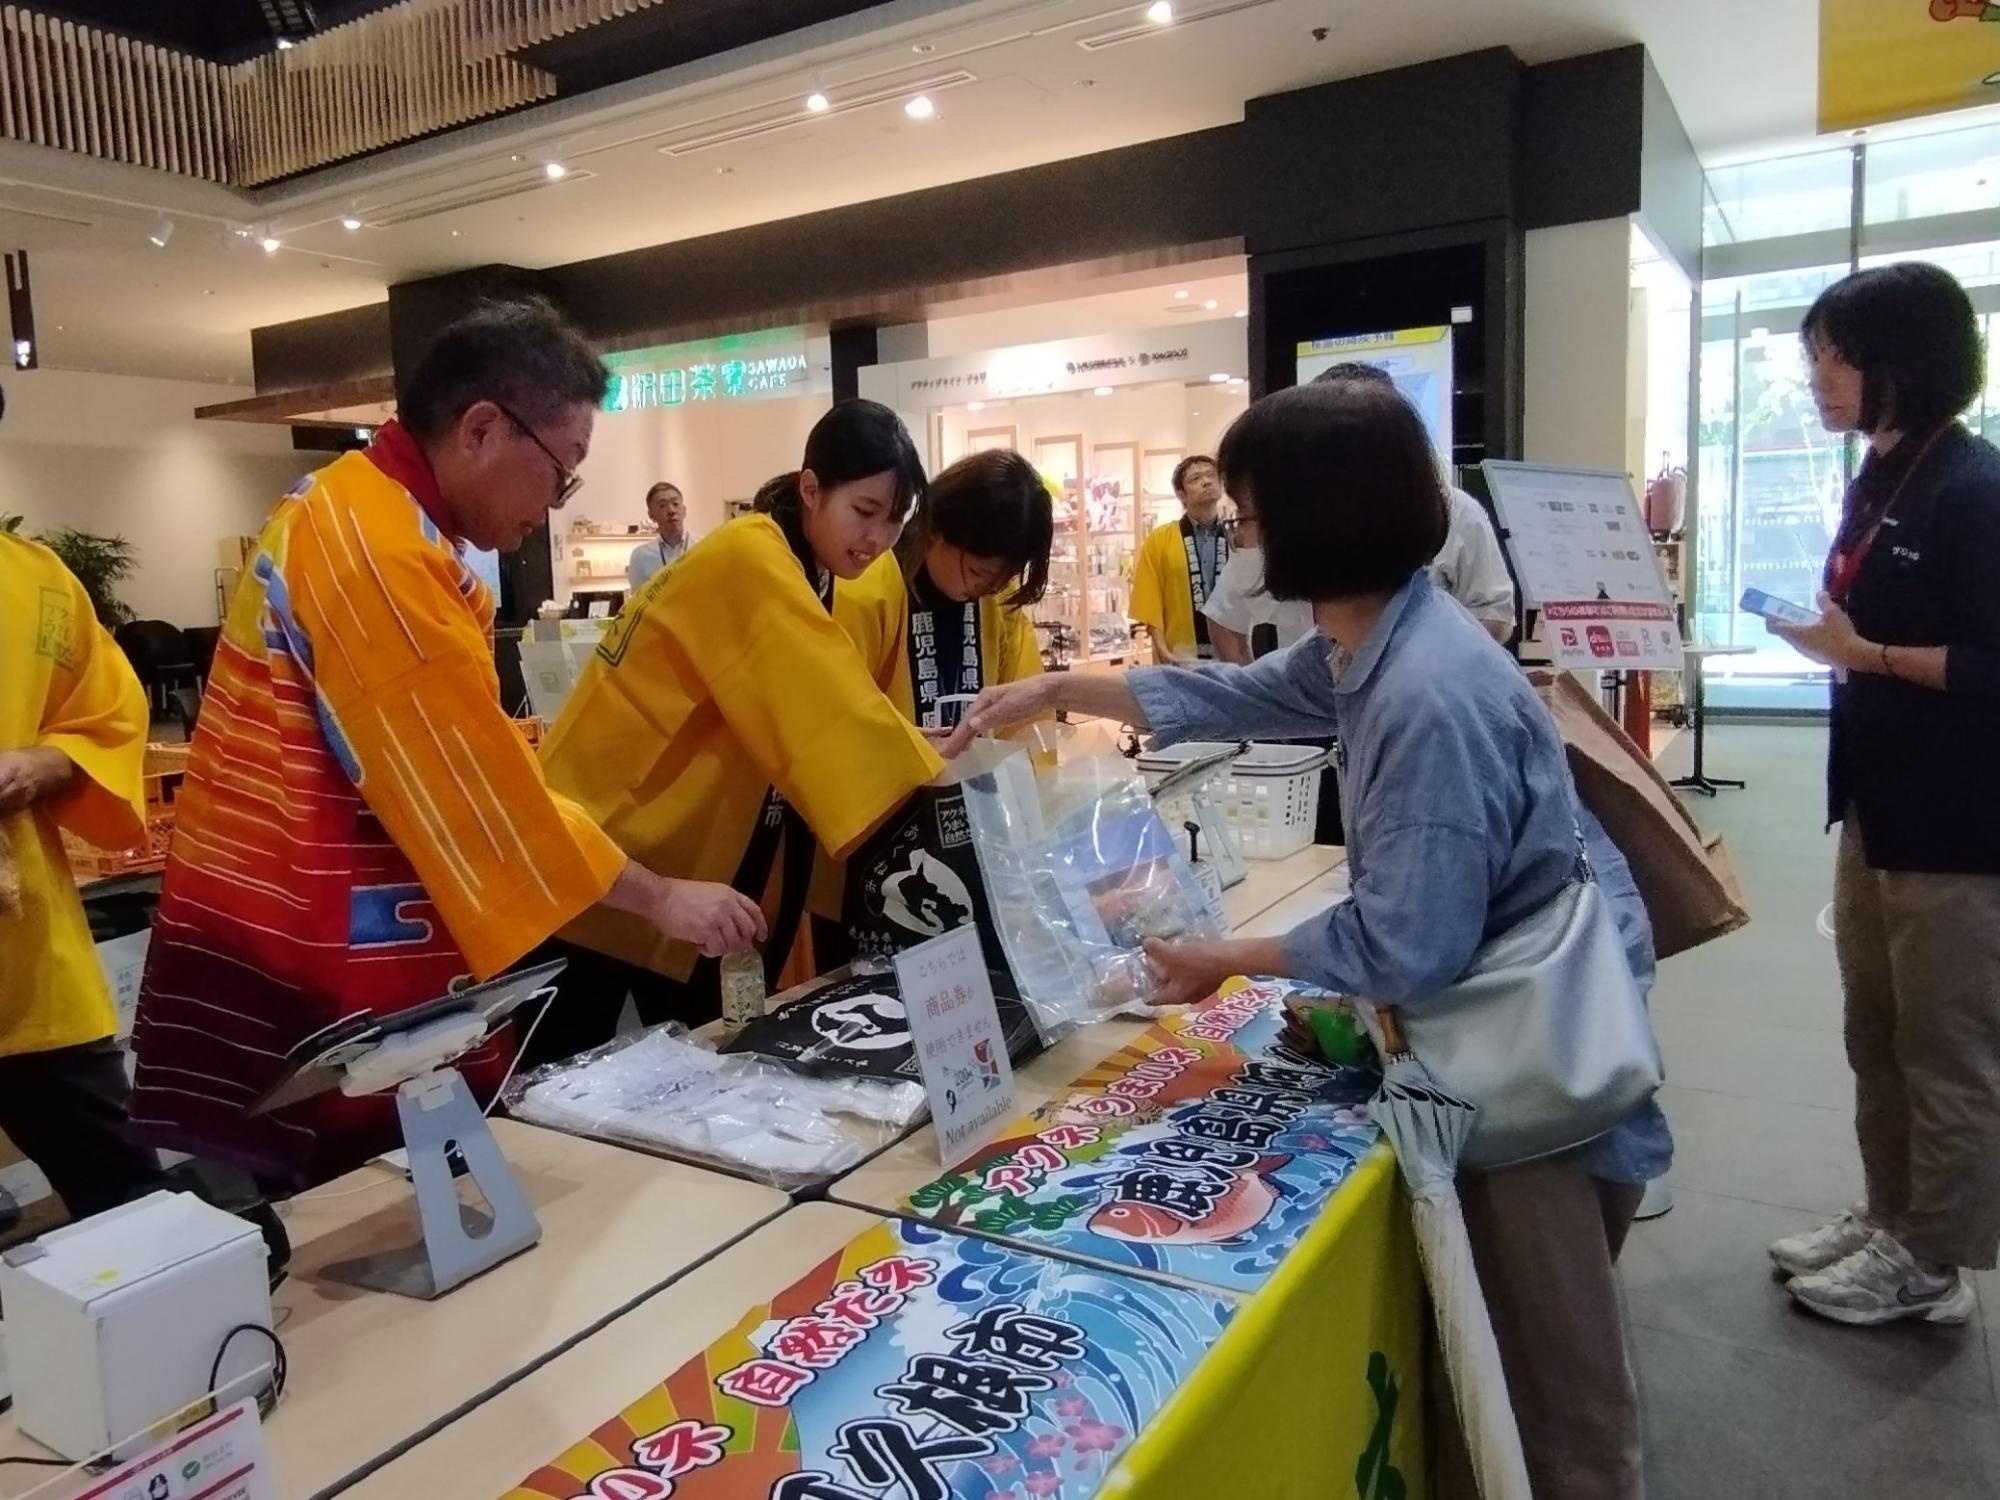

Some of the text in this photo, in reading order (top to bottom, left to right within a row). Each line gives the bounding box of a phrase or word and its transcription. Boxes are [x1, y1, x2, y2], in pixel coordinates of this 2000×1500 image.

[912, 611, 940, 704] 鹿児島県
[962, 602, 979, 690] 鹿児島県
[945, 1094, 1013, 1149] Not available
[983, 1124, 1101, 1198] アクネ
[1077, 1047, 1203, 1116] うまいネ
[714, 1256, 942, 1407] 自然だネ
